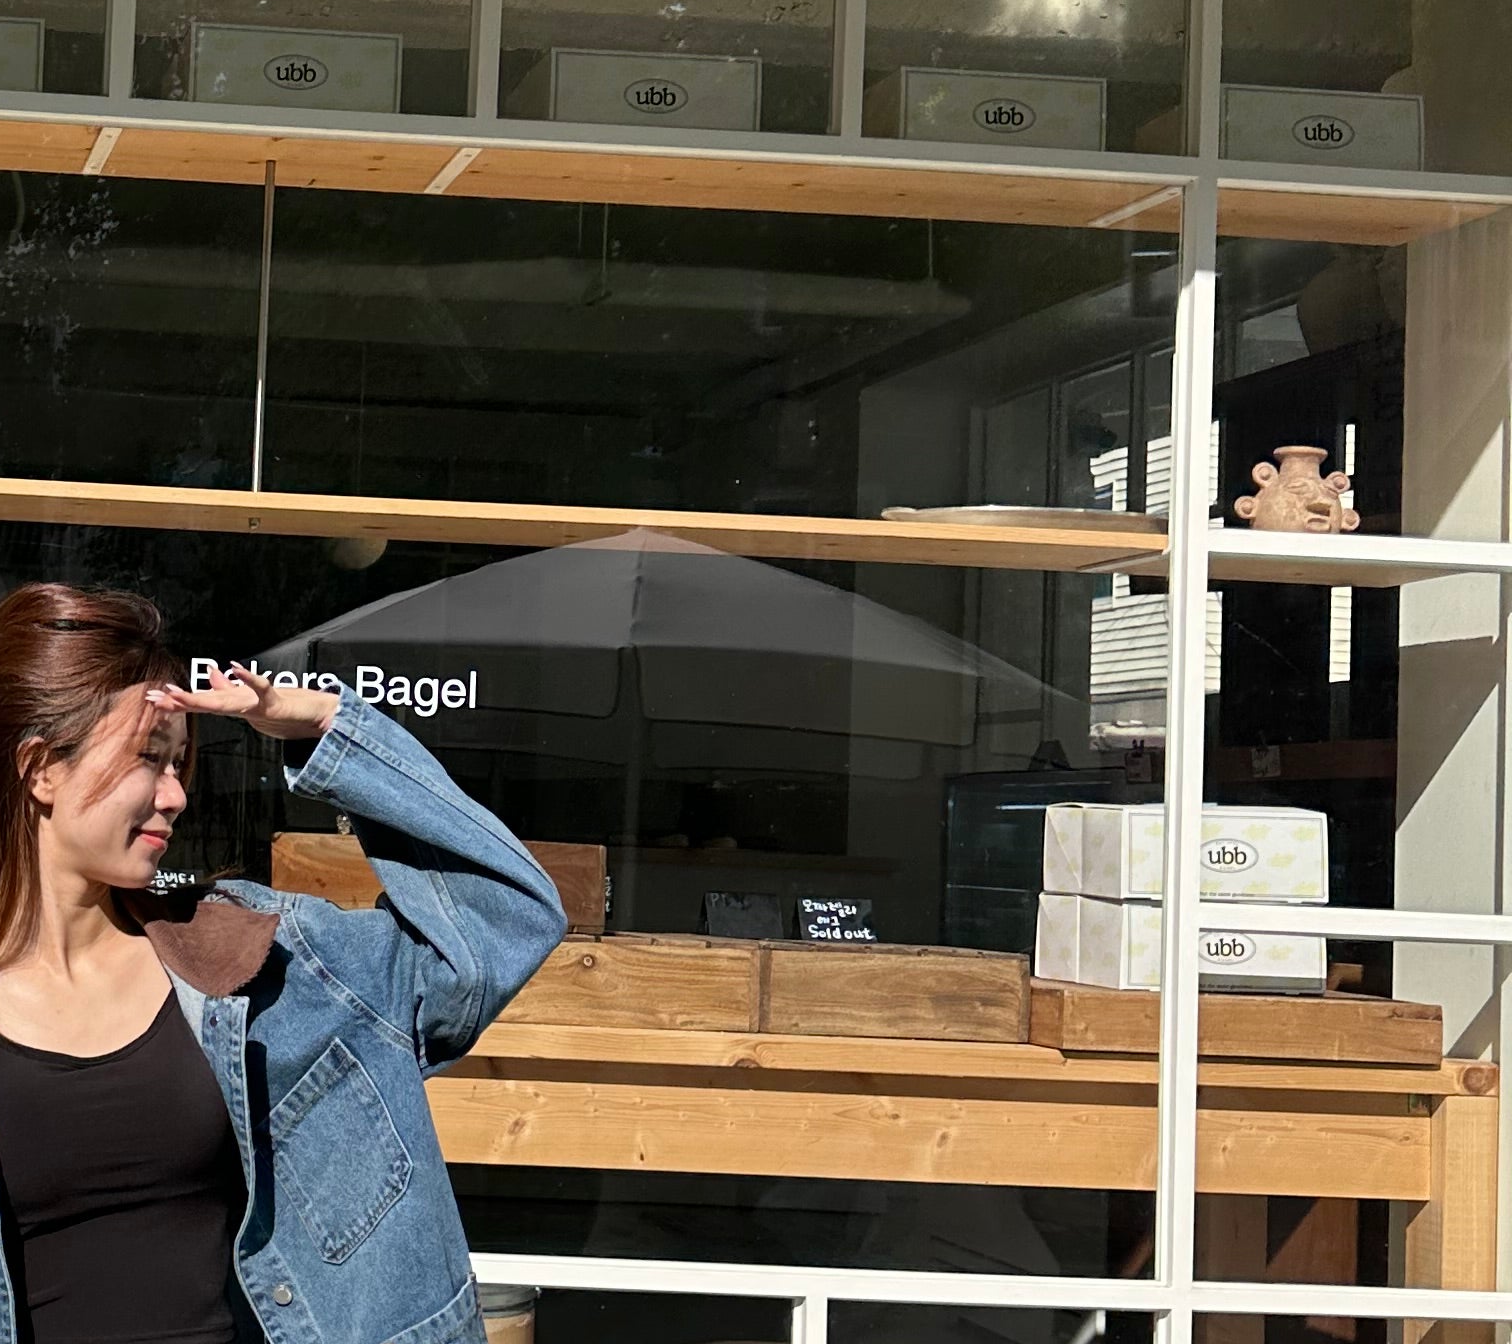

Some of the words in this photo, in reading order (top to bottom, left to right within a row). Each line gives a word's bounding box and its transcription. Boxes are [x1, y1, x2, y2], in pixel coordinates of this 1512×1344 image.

[276, 62, 317, 83] ubb
[636, 86, 676, 106] ubb
[984, 106, 1024, 126] ubb
[1304, 123, 1343, 142] ubb
[356, 665, 477, 717] Bagel
[1208, 845, 1247, 865] ubb
[808, 924, 842, 940] Sold
[843, 927, 877, 941] out
[1206, 937, 1245, 957] ubb
